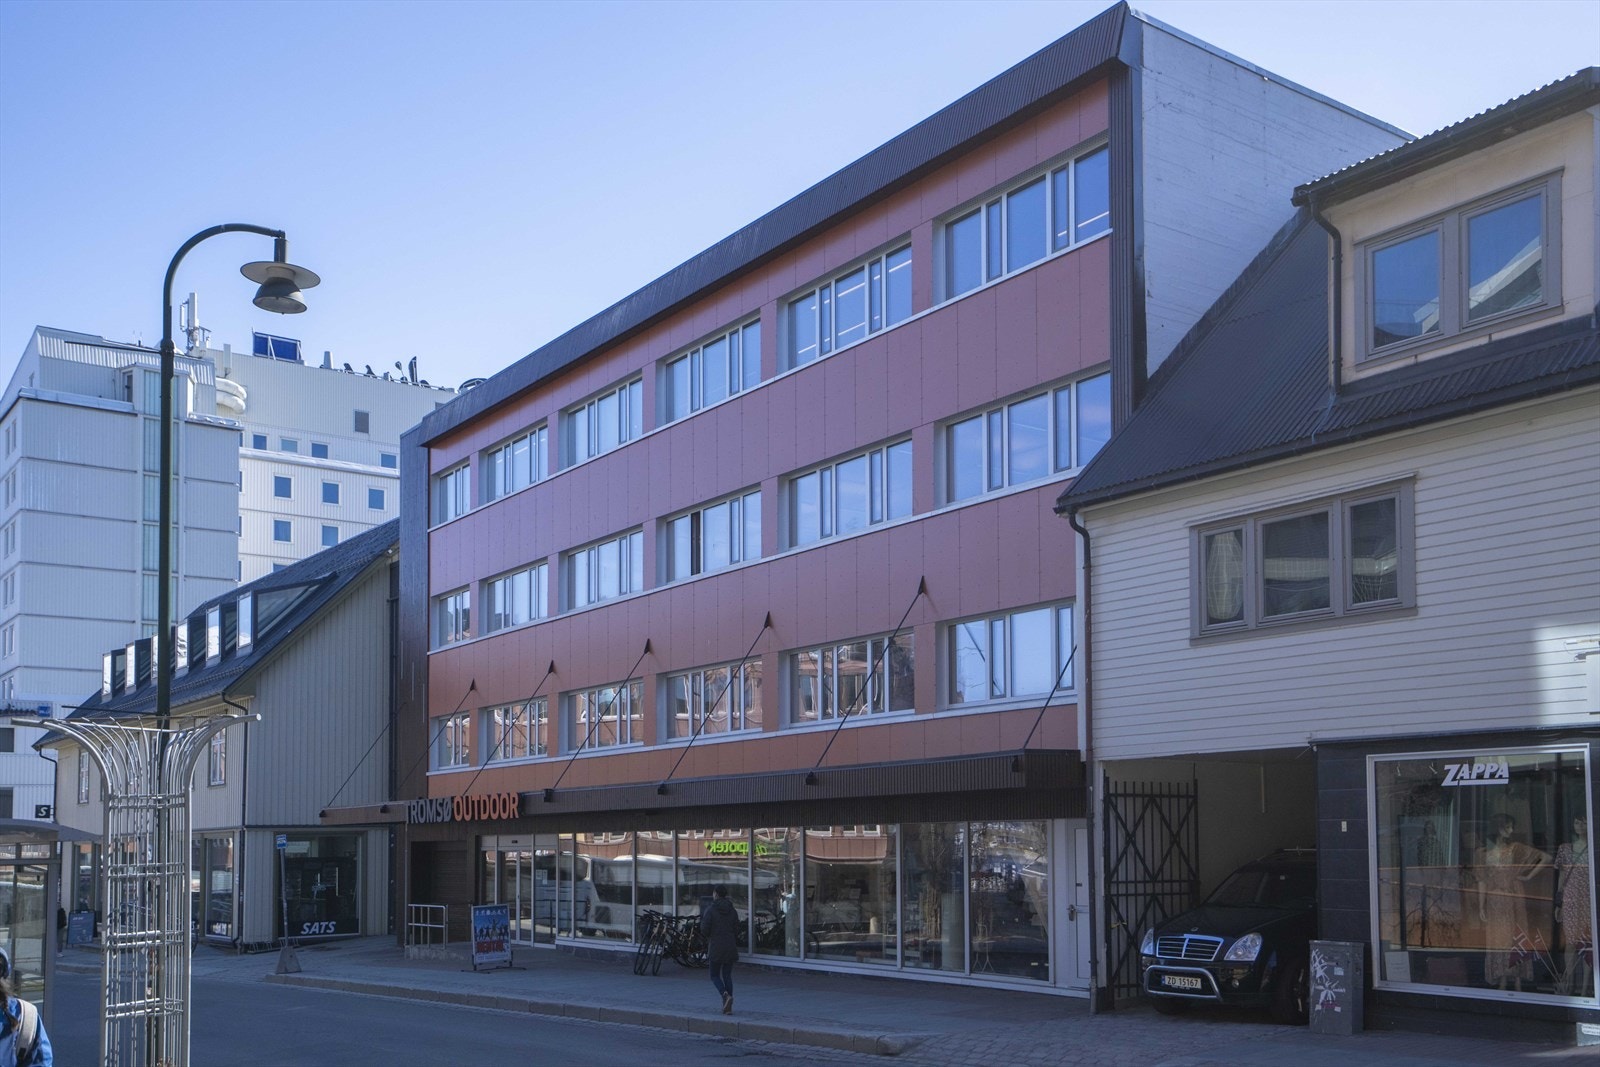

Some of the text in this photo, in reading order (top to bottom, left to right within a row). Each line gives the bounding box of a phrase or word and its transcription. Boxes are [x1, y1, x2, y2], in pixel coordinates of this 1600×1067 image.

[1441, 762, 1509, 786] ZAPPA
[406, 793, 519, 824] TROMSØ OUTDOOR
[300, 921, 336, 935] SATS
[1179, 978, 1199, 987] 15167
